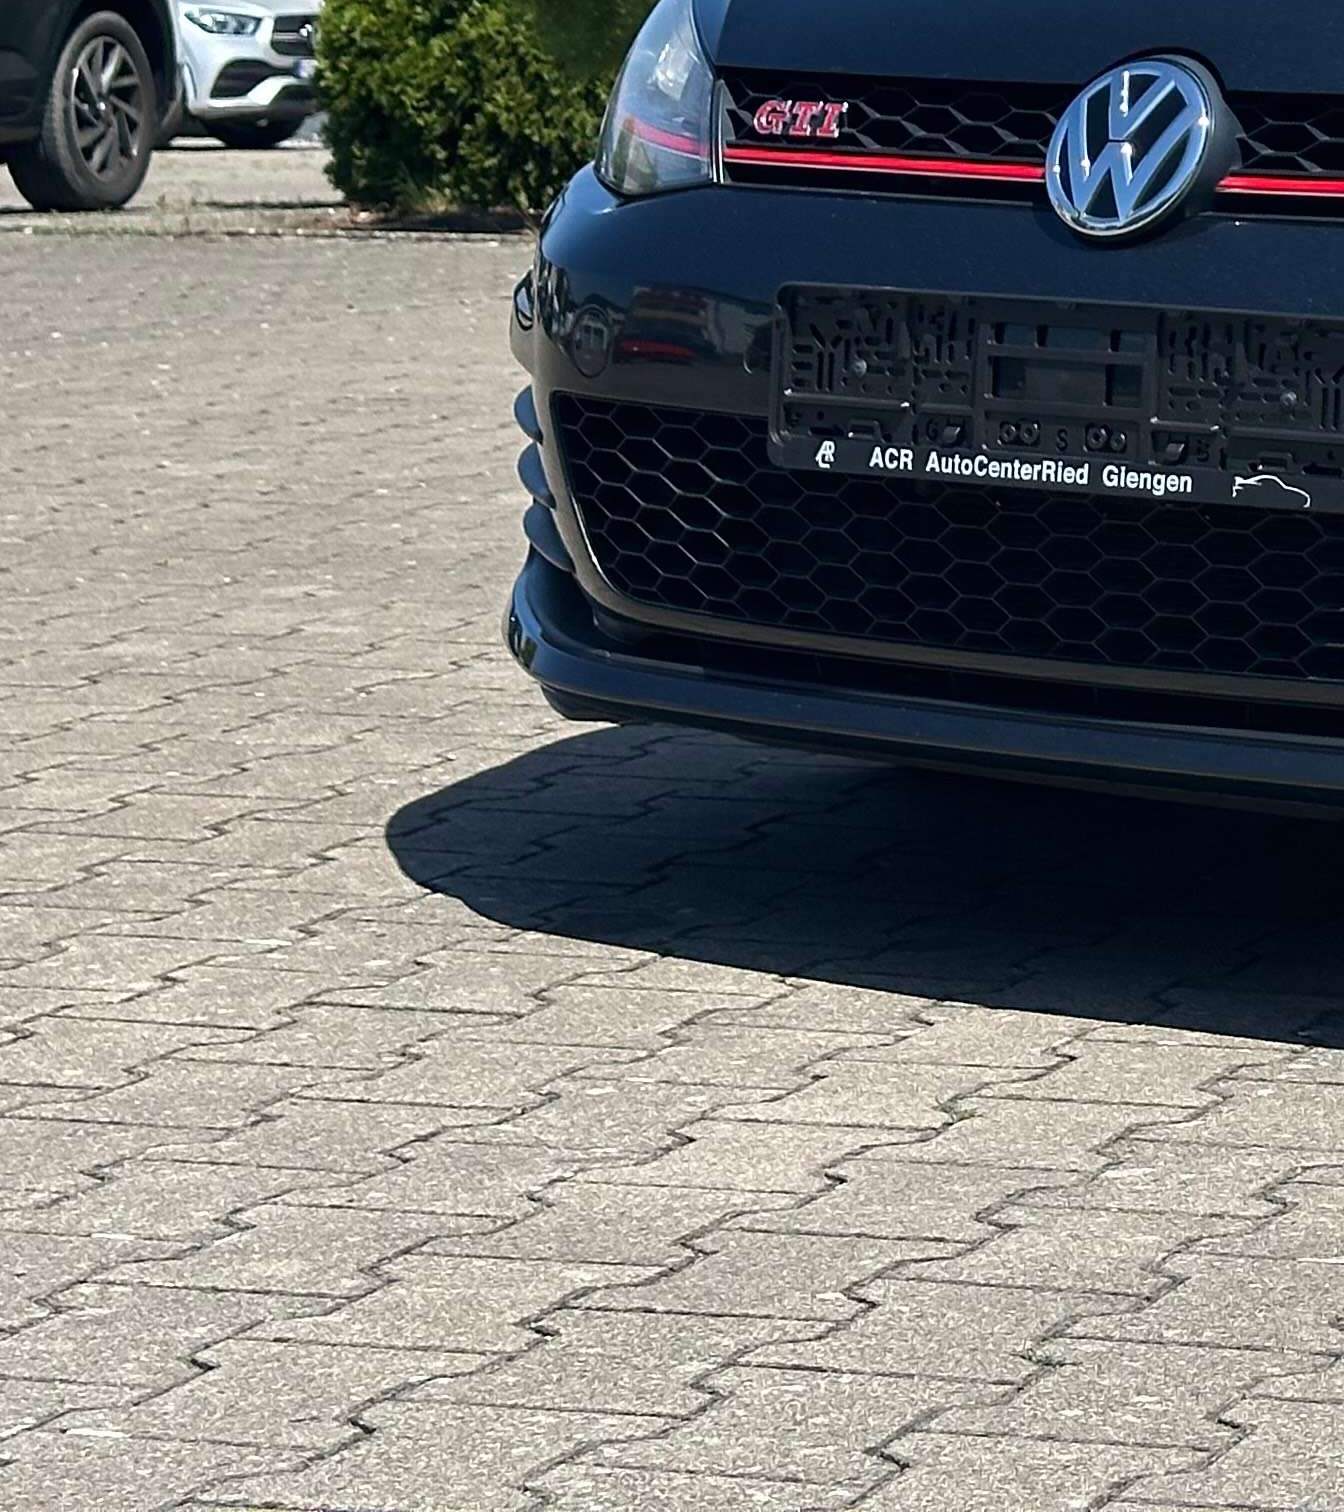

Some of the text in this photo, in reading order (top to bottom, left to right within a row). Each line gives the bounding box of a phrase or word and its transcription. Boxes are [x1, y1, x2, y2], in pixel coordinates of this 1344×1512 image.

[753, 99, 849, 139] GTI
[869, 446, 914, 471] ACR
[925, 451, 1089, 485] AutoCenterRied
